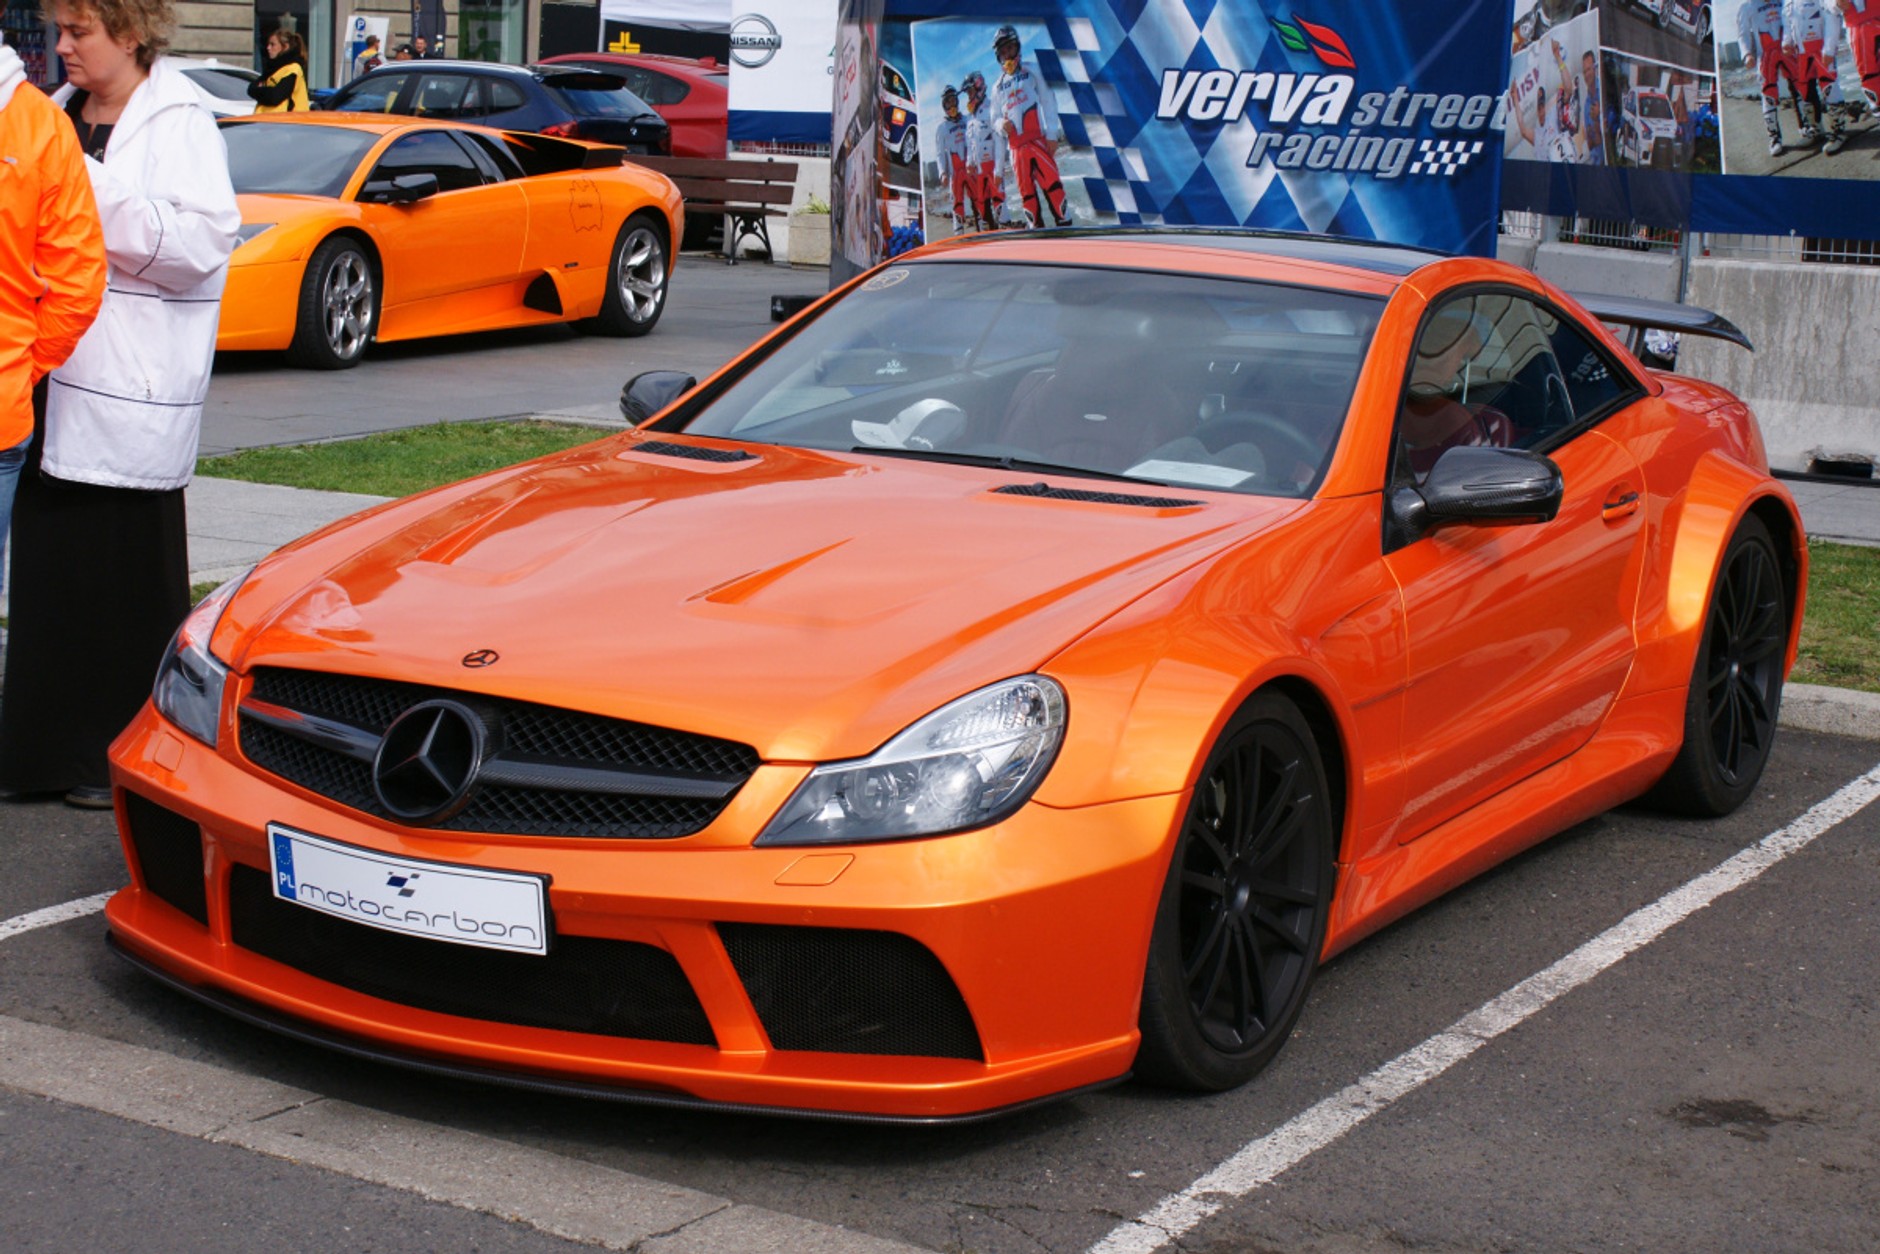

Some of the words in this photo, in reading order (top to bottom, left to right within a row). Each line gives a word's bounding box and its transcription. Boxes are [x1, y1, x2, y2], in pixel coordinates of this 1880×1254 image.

[357, 20, 365, 30] P
[1157, 70, 1354, 125] verva
[1248, 128, 1415, 178] racing
[279, 872, 295, 888] PL
[300, 882, 536, 940] motocarbon
